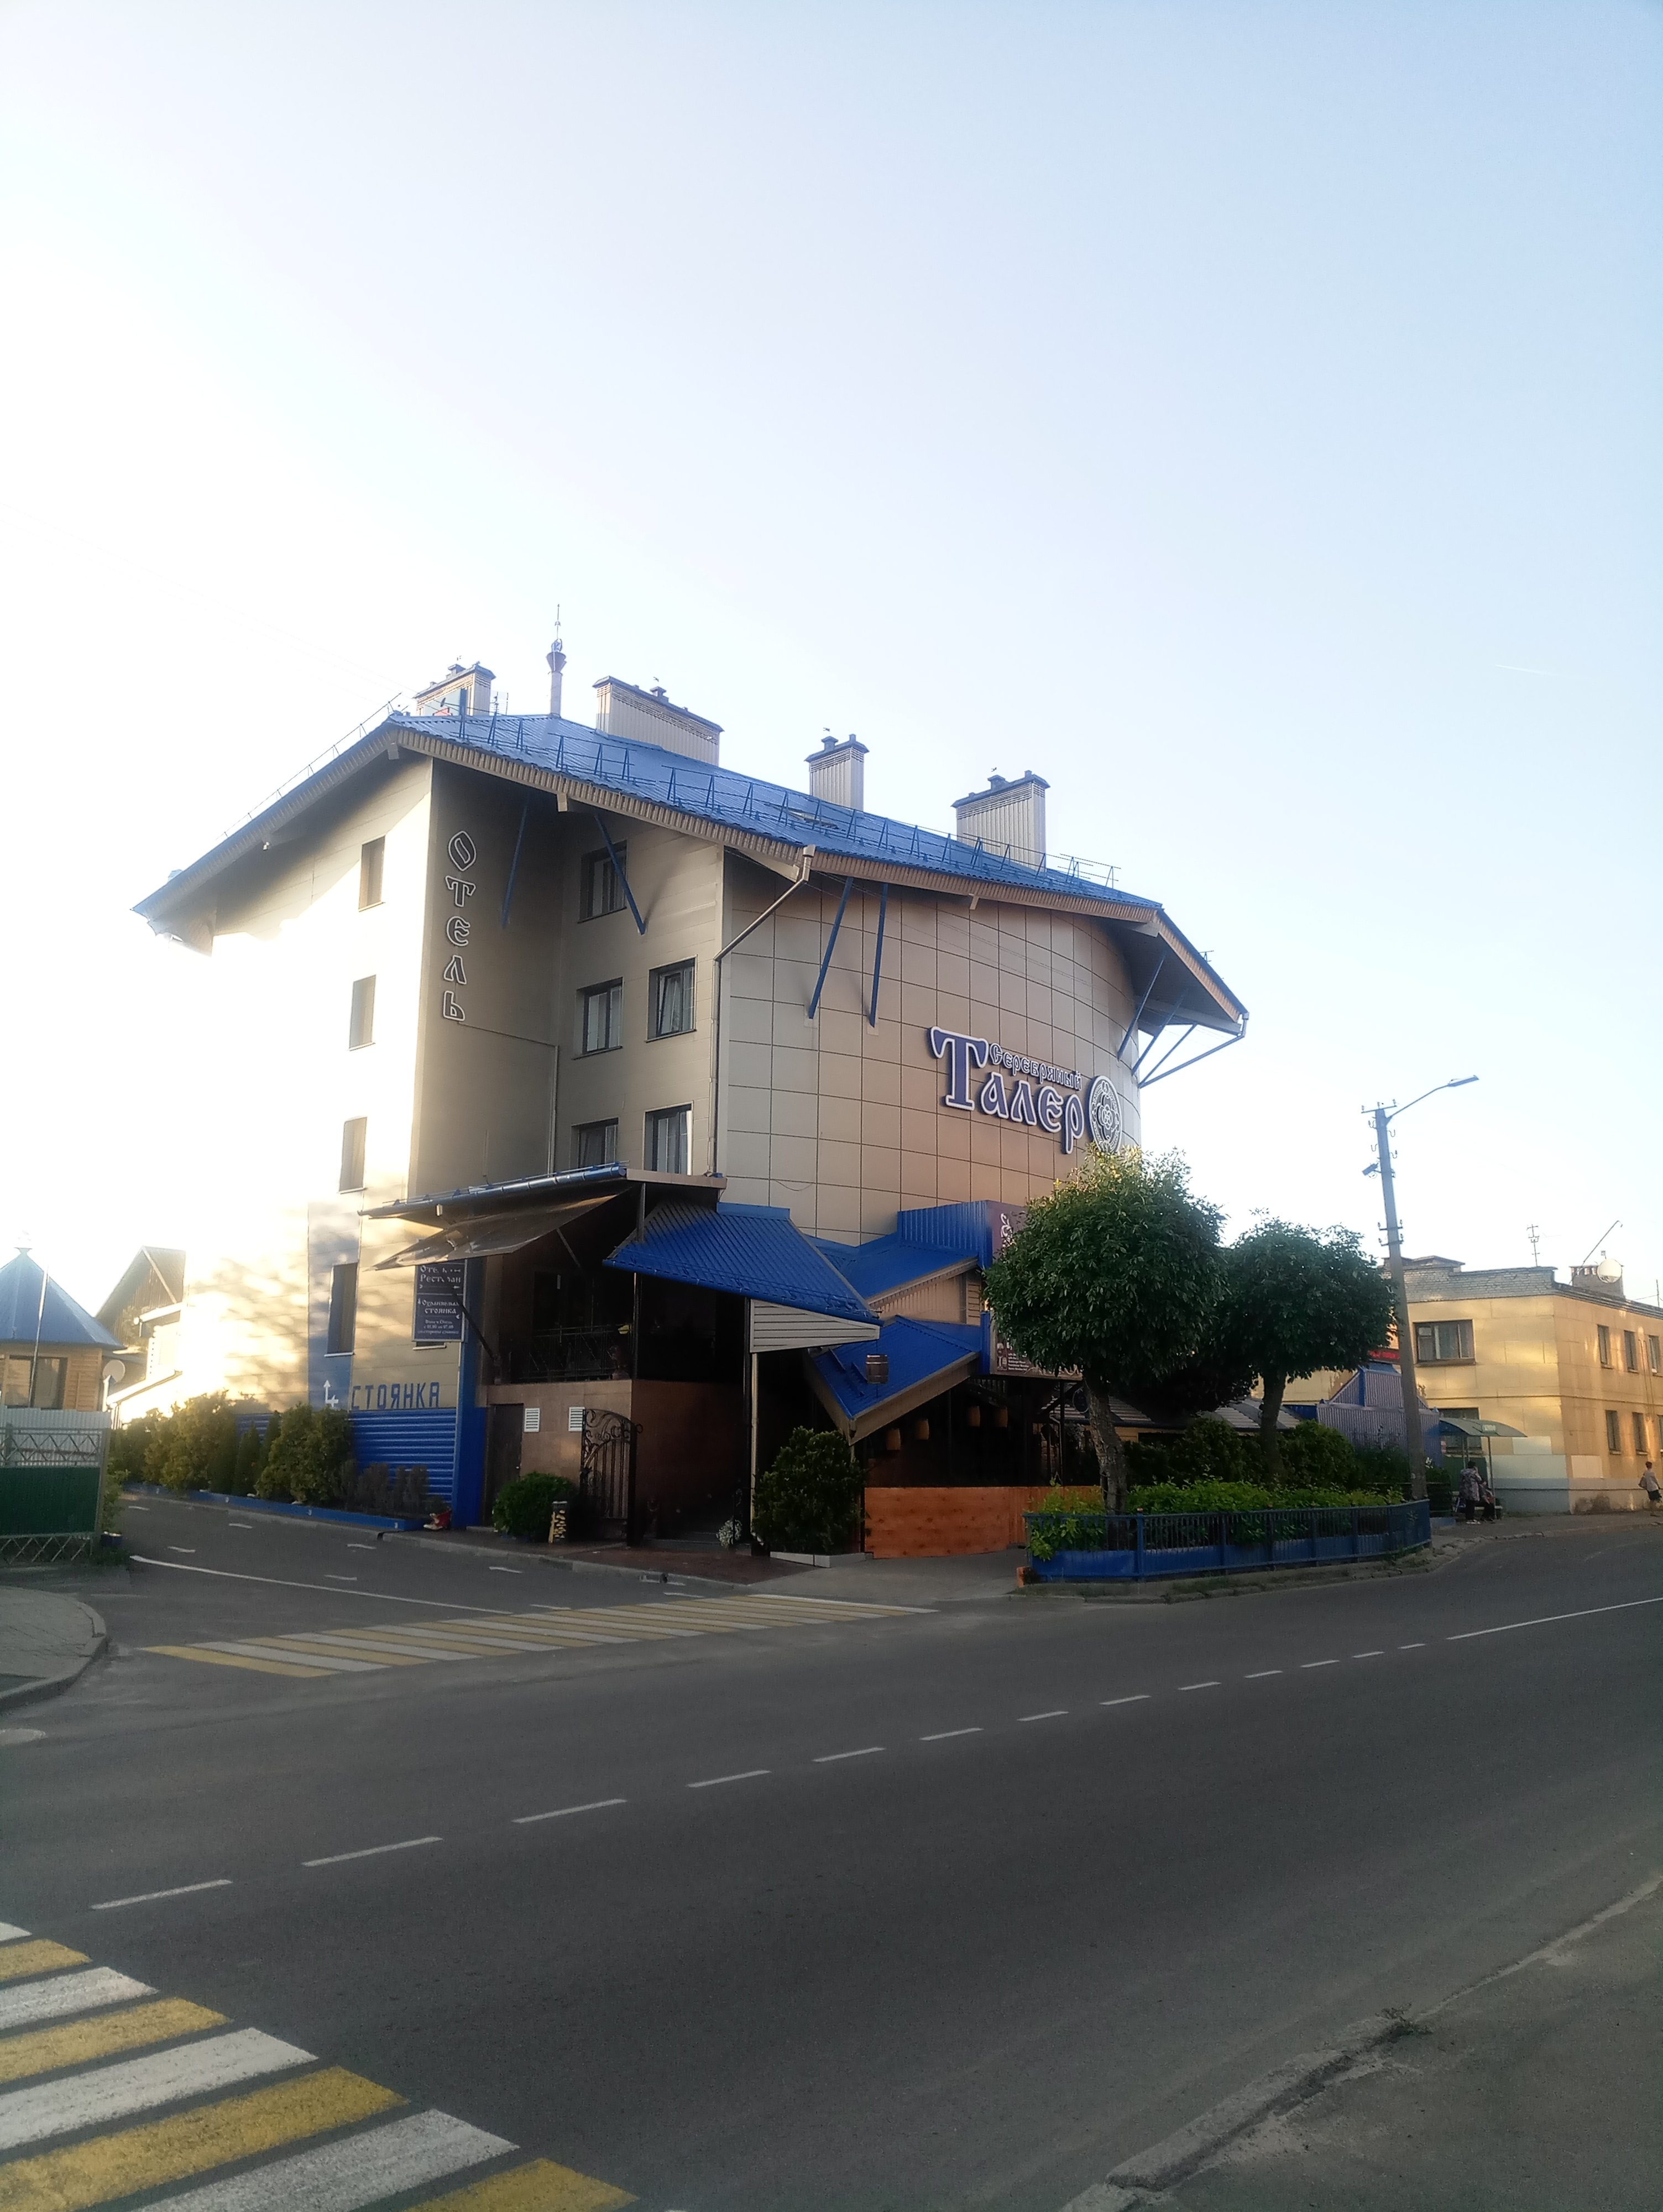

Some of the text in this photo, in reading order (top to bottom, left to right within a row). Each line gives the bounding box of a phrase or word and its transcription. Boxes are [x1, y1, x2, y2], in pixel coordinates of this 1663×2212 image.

[989, 1042, 1082, 1091] Серебряный
[928, 1026, 1084, 1154] Талер
[420, 1265, 447, 1273] Отеь
[351, 1382, 440, 1410] СТОЯНКА
